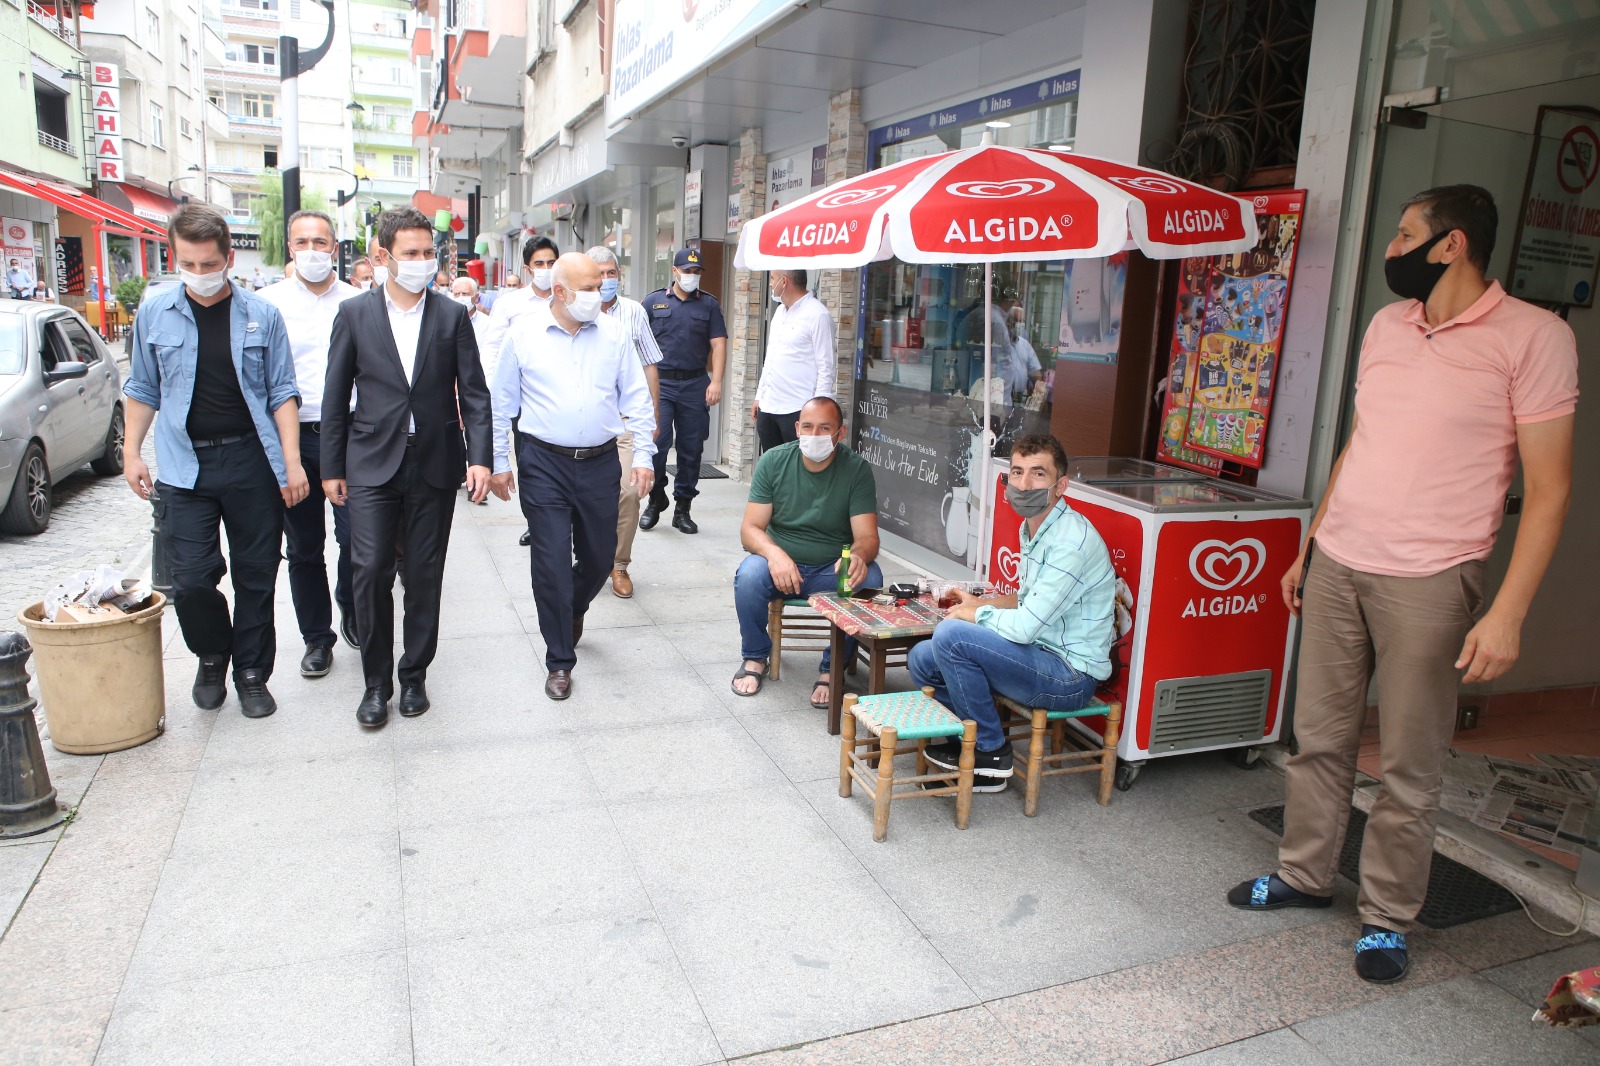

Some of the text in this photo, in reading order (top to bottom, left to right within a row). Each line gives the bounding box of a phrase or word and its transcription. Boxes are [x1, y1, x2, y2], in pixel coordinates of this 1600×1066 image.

[616, 20, 642, 65] İhlas
[614, 30, 674, 101] Pazarlama
[95, 65, 119, 179] BAHAR
[56, 244, 69, 294] ADRESS
[858, 400, 888, 419] SILVER
[870, 426, 881, 441] 72
[885, 449, 896, 471] Su
[898, 453, 916, 477] Her
[918, 459, 939, 485] Evde
